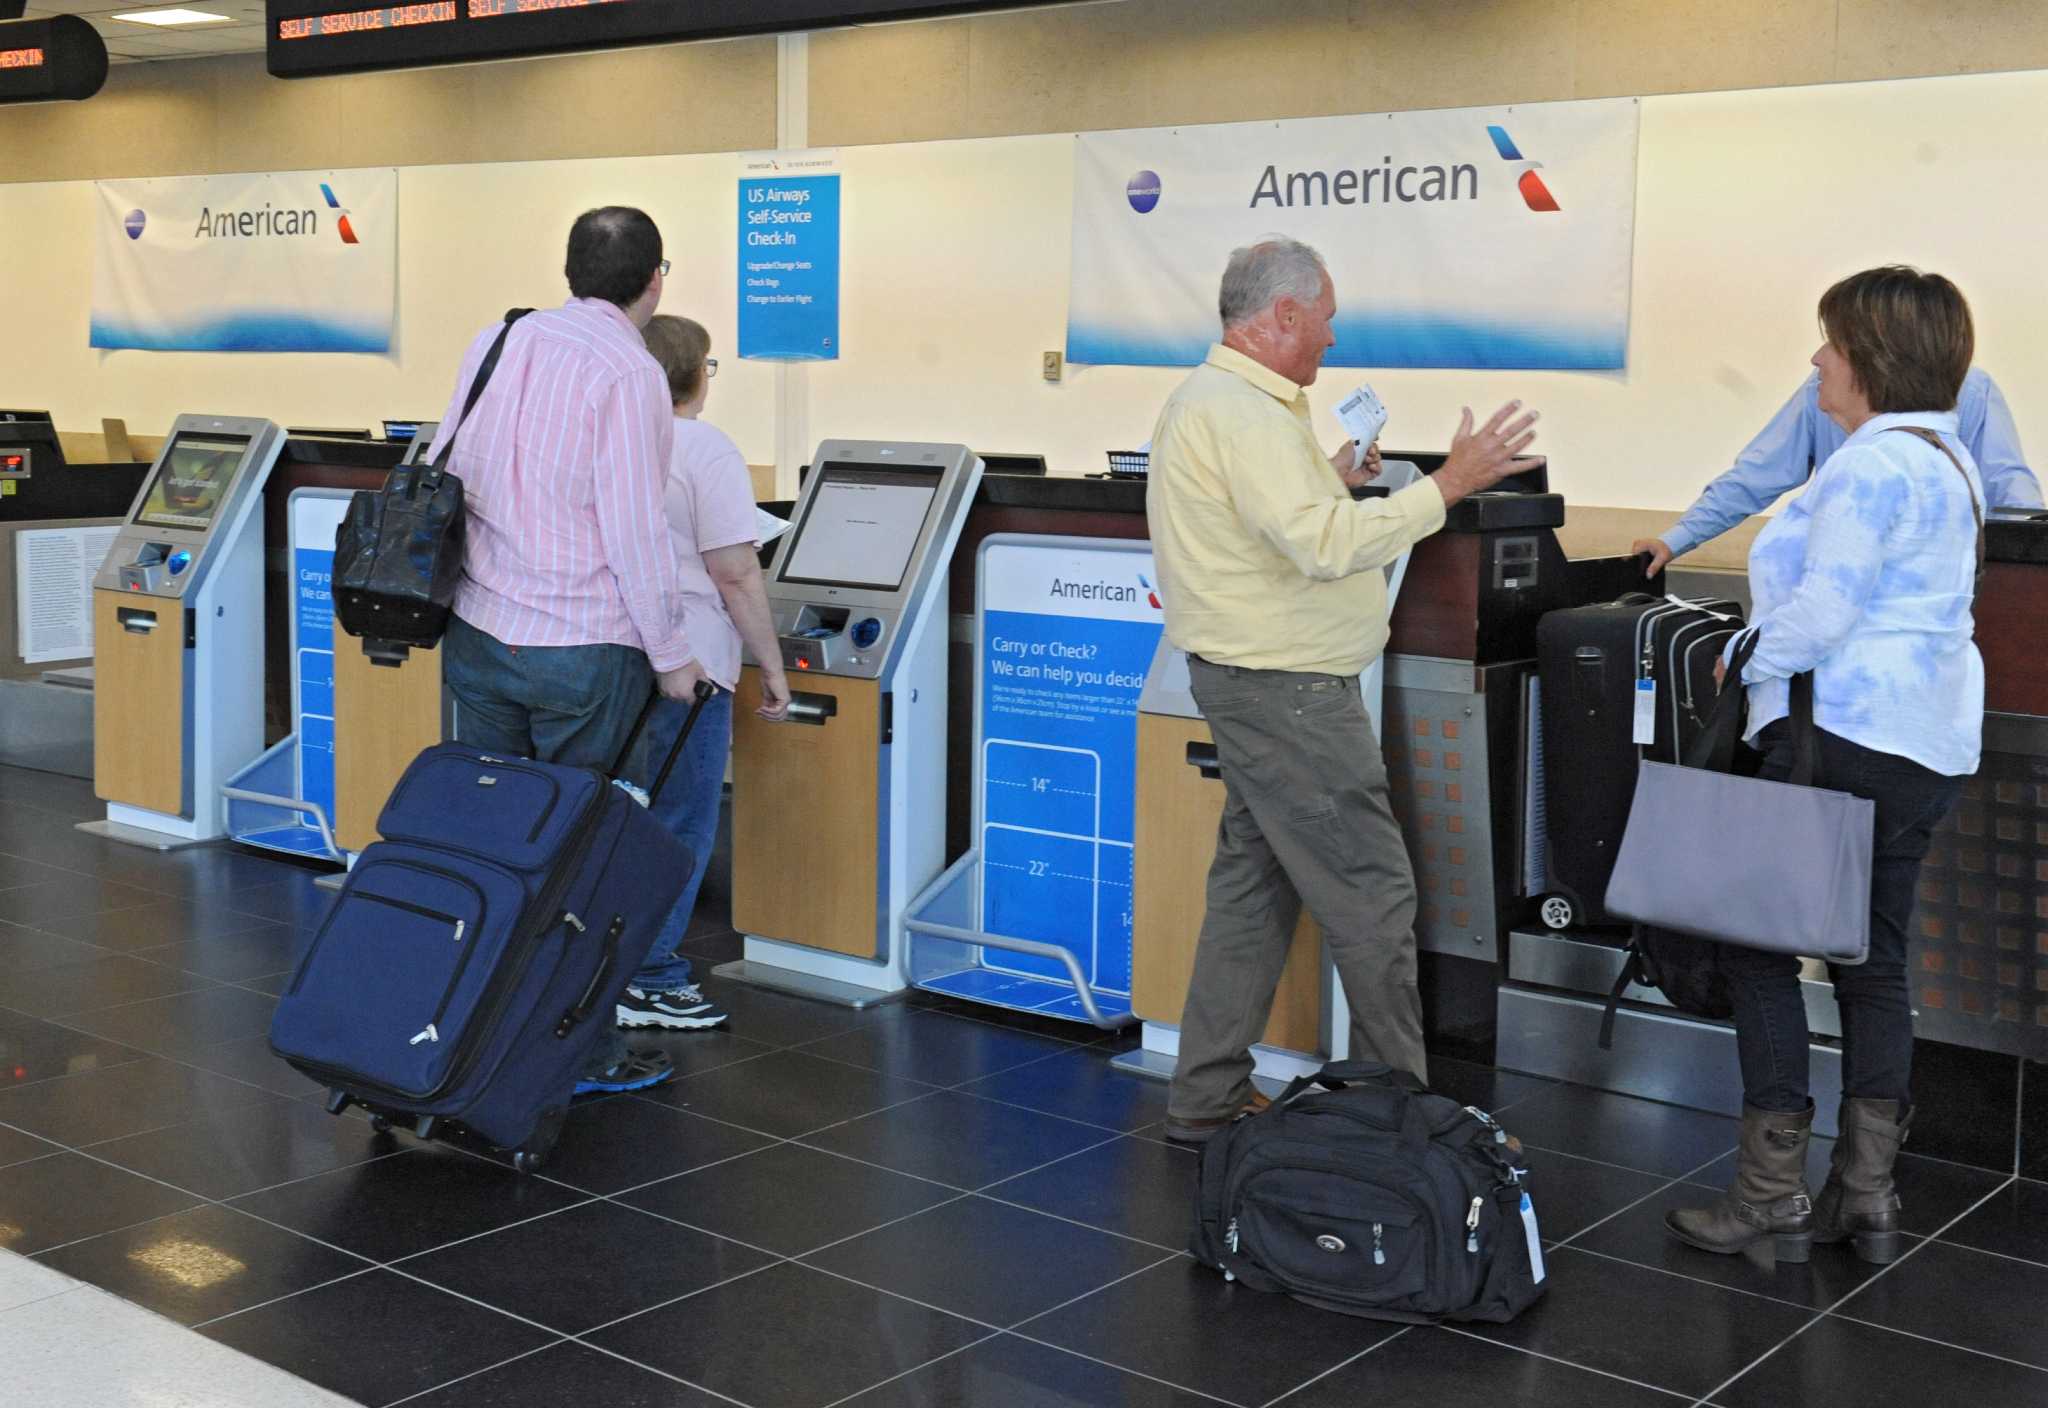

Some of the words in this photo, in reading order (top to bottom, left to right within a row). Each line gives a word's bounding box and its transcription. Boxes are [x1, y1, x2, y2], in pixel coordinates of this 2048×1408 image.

[279, 18, 313, 39] SELF
[320, 9, 384, 34] SERVICE
[390, 1, 456, 27] CHECKIN
[1249, 156, 1477, 208] American
[747, 188, 764, 203] US
[766, 187, 811, 206] Airways
[195, 203, 316, 238] American
[747, 208, 812, 224] Self-Service
[747, 231, 796, 246] Check-In
[300, 568, 322, 586] Carry
[1050, 578, 1136, 602] American
[992, 636, 1028, 658] Carry
[1031, 645, 1046, 656] or
[1050, 641, 1097, 661] Check?
[992, 660, 1013, 676] We
[1016, 664, 1040, 679] can
[1043, 664, 1073, 686] help
[1076, 671, 1102, 687] you
[1105, 670, 1144, 689] decid
[1031, 777, 1051, 793] 14"
[1028, 860, 1050, 877] 22"
